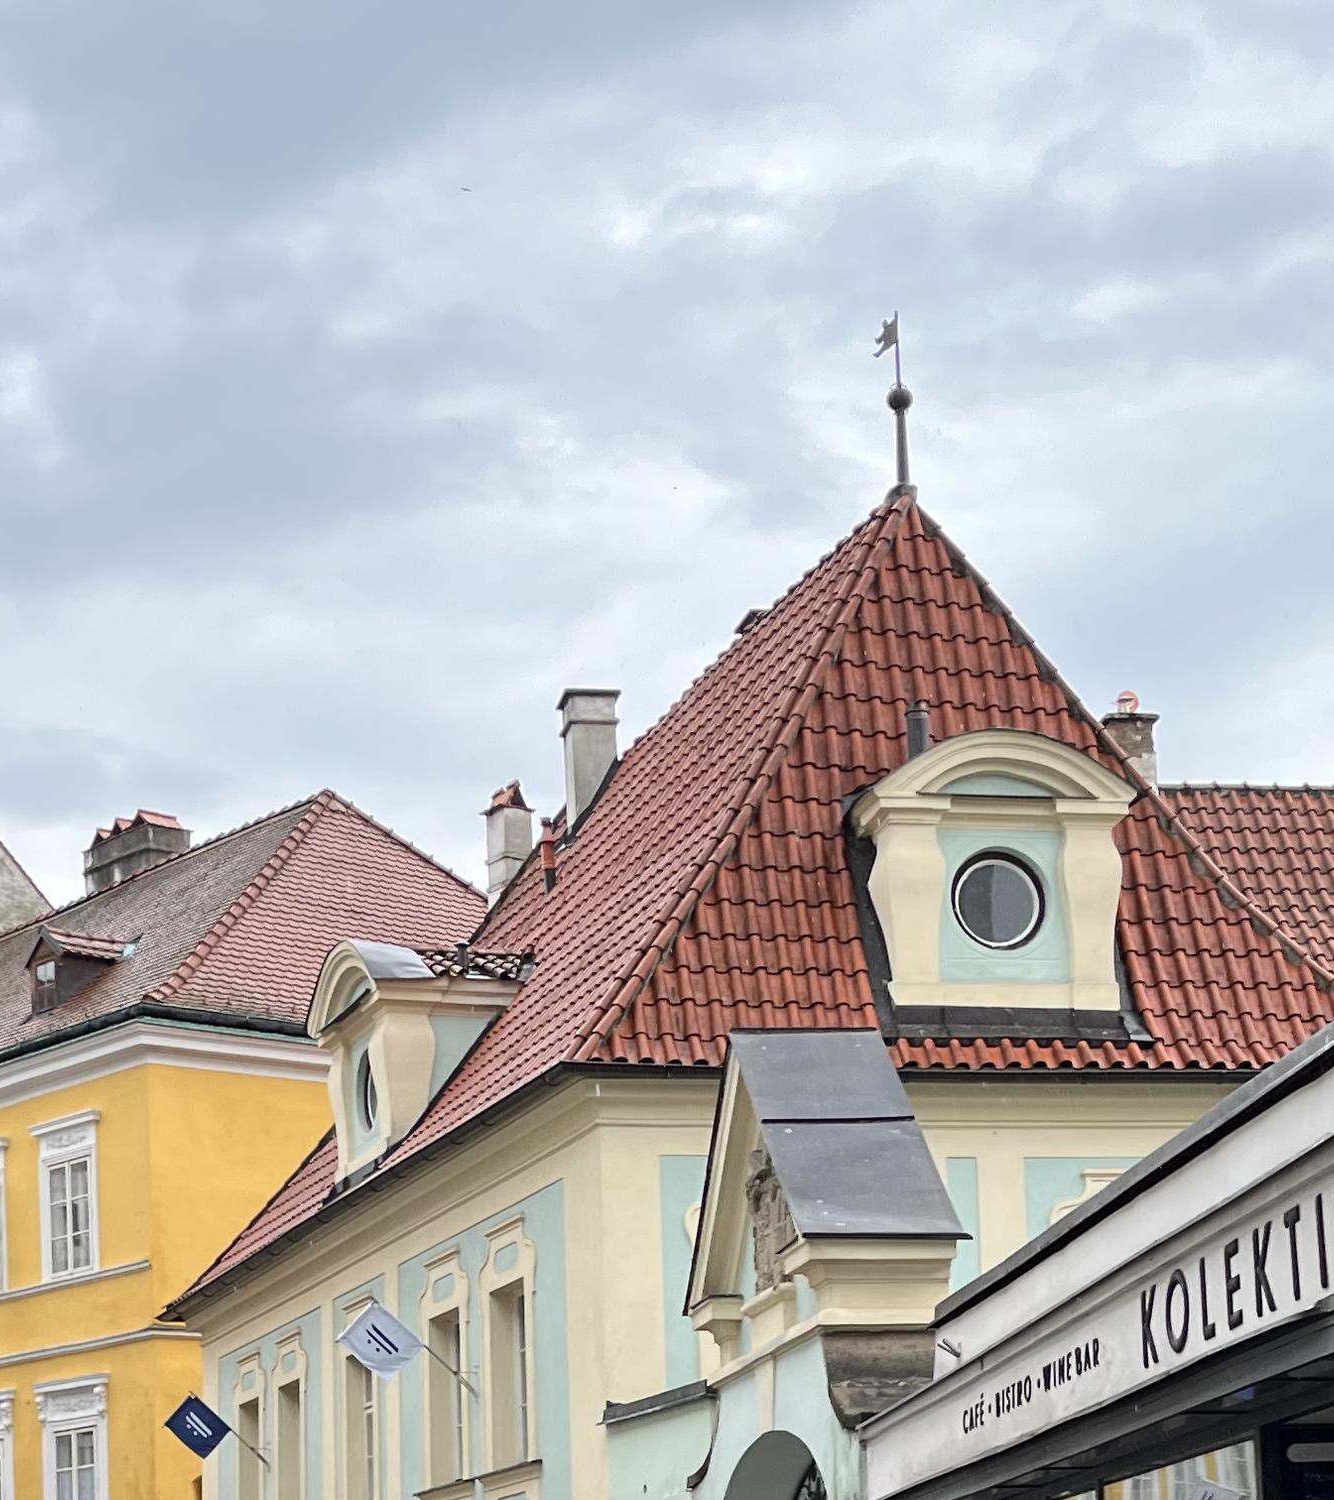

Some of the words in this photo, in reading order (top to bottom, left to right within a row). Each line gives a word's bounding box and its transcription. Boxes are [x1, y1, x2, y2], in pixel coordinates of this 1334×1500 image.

[962, 1393, 984, 1434] CAFÉ
[995, 1375, 1032, 1418] BISTRO
[1042, 1352, 1072, 1392] WINE
[1074, 1338, 1100, 1375] BAR
